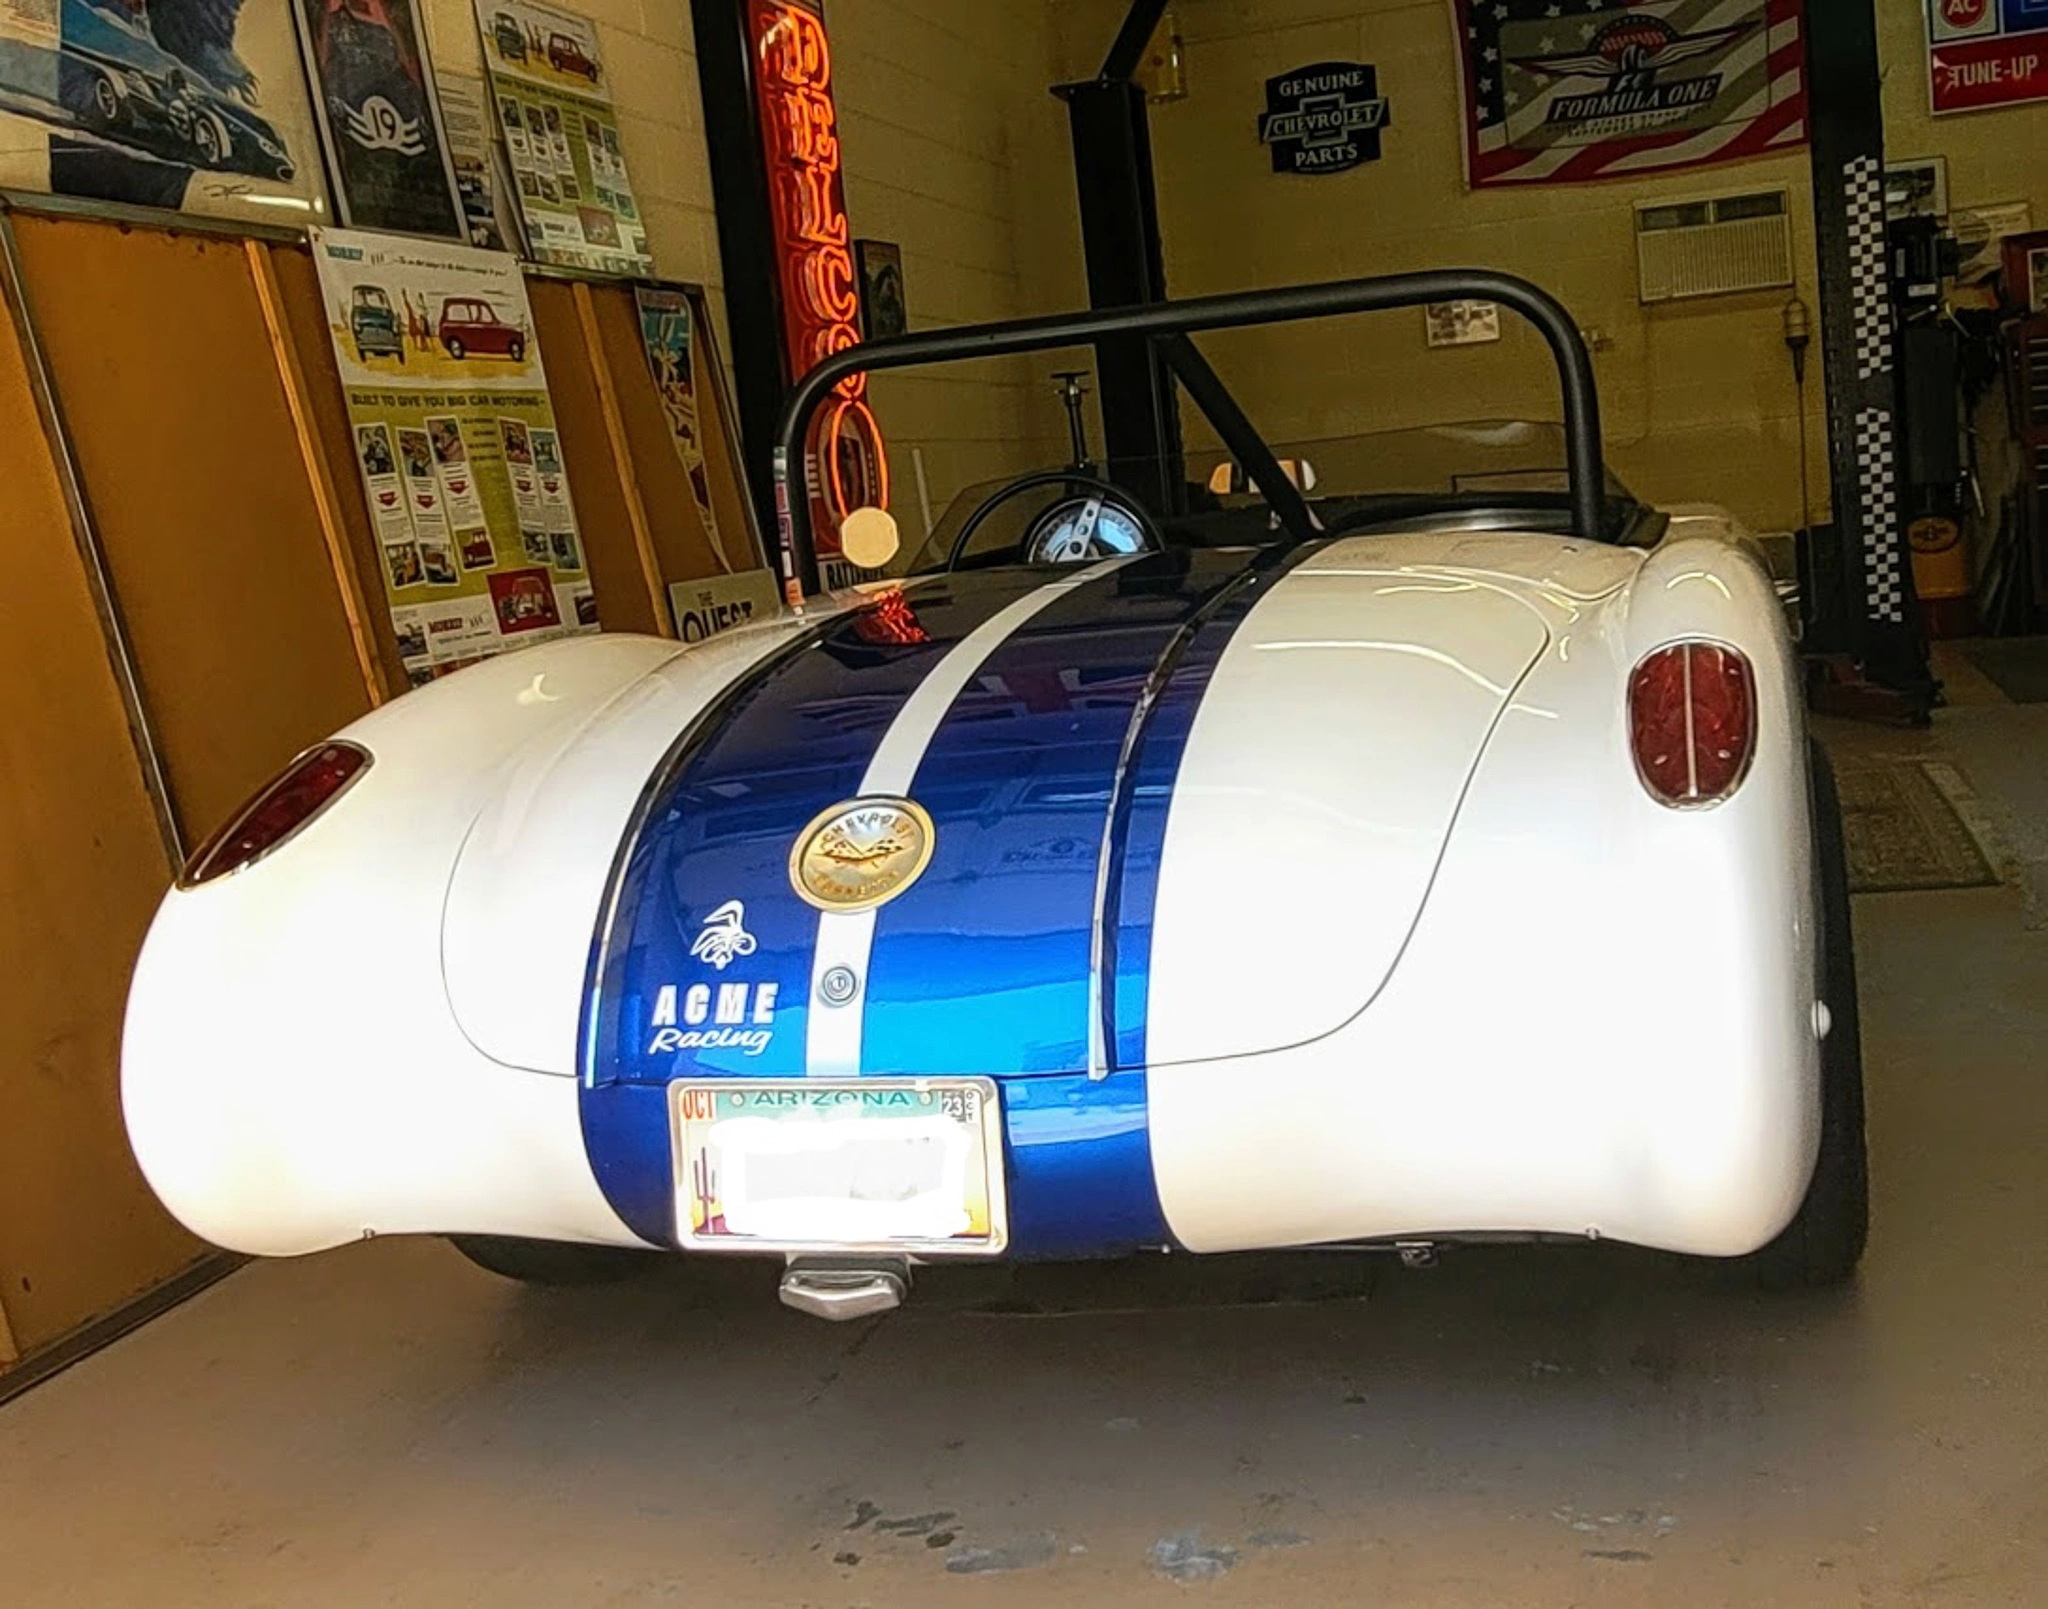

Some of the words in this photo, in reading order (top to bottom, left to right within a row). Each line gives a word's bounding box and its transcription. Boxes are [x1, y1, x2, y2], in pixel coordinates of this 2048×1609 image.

[1947, 0, 1979, 16] AC
[1279, 71, 1364, 97] GENUINE
[1944, 54, 2038, 88] TUNE-UP
[1553, 89, 1660, 120] FORMULA
[1667, 78, 1718, 105] ONE
[371, 106, 396, 140] 19
[1273, 106, 1375, 135] CHEVROLET
[1295, 143, 1358, 167] PARTS
[697, 591, 714, 607] THE
[651, 982, 779, 1027] ACME
[648, 1027, 773, 1056] Racing
[682, 1090, 713, 1120] OCT
[754, 1090, 910, 1107] ARIZONA
[943, 1096, 963, 1117] 23
